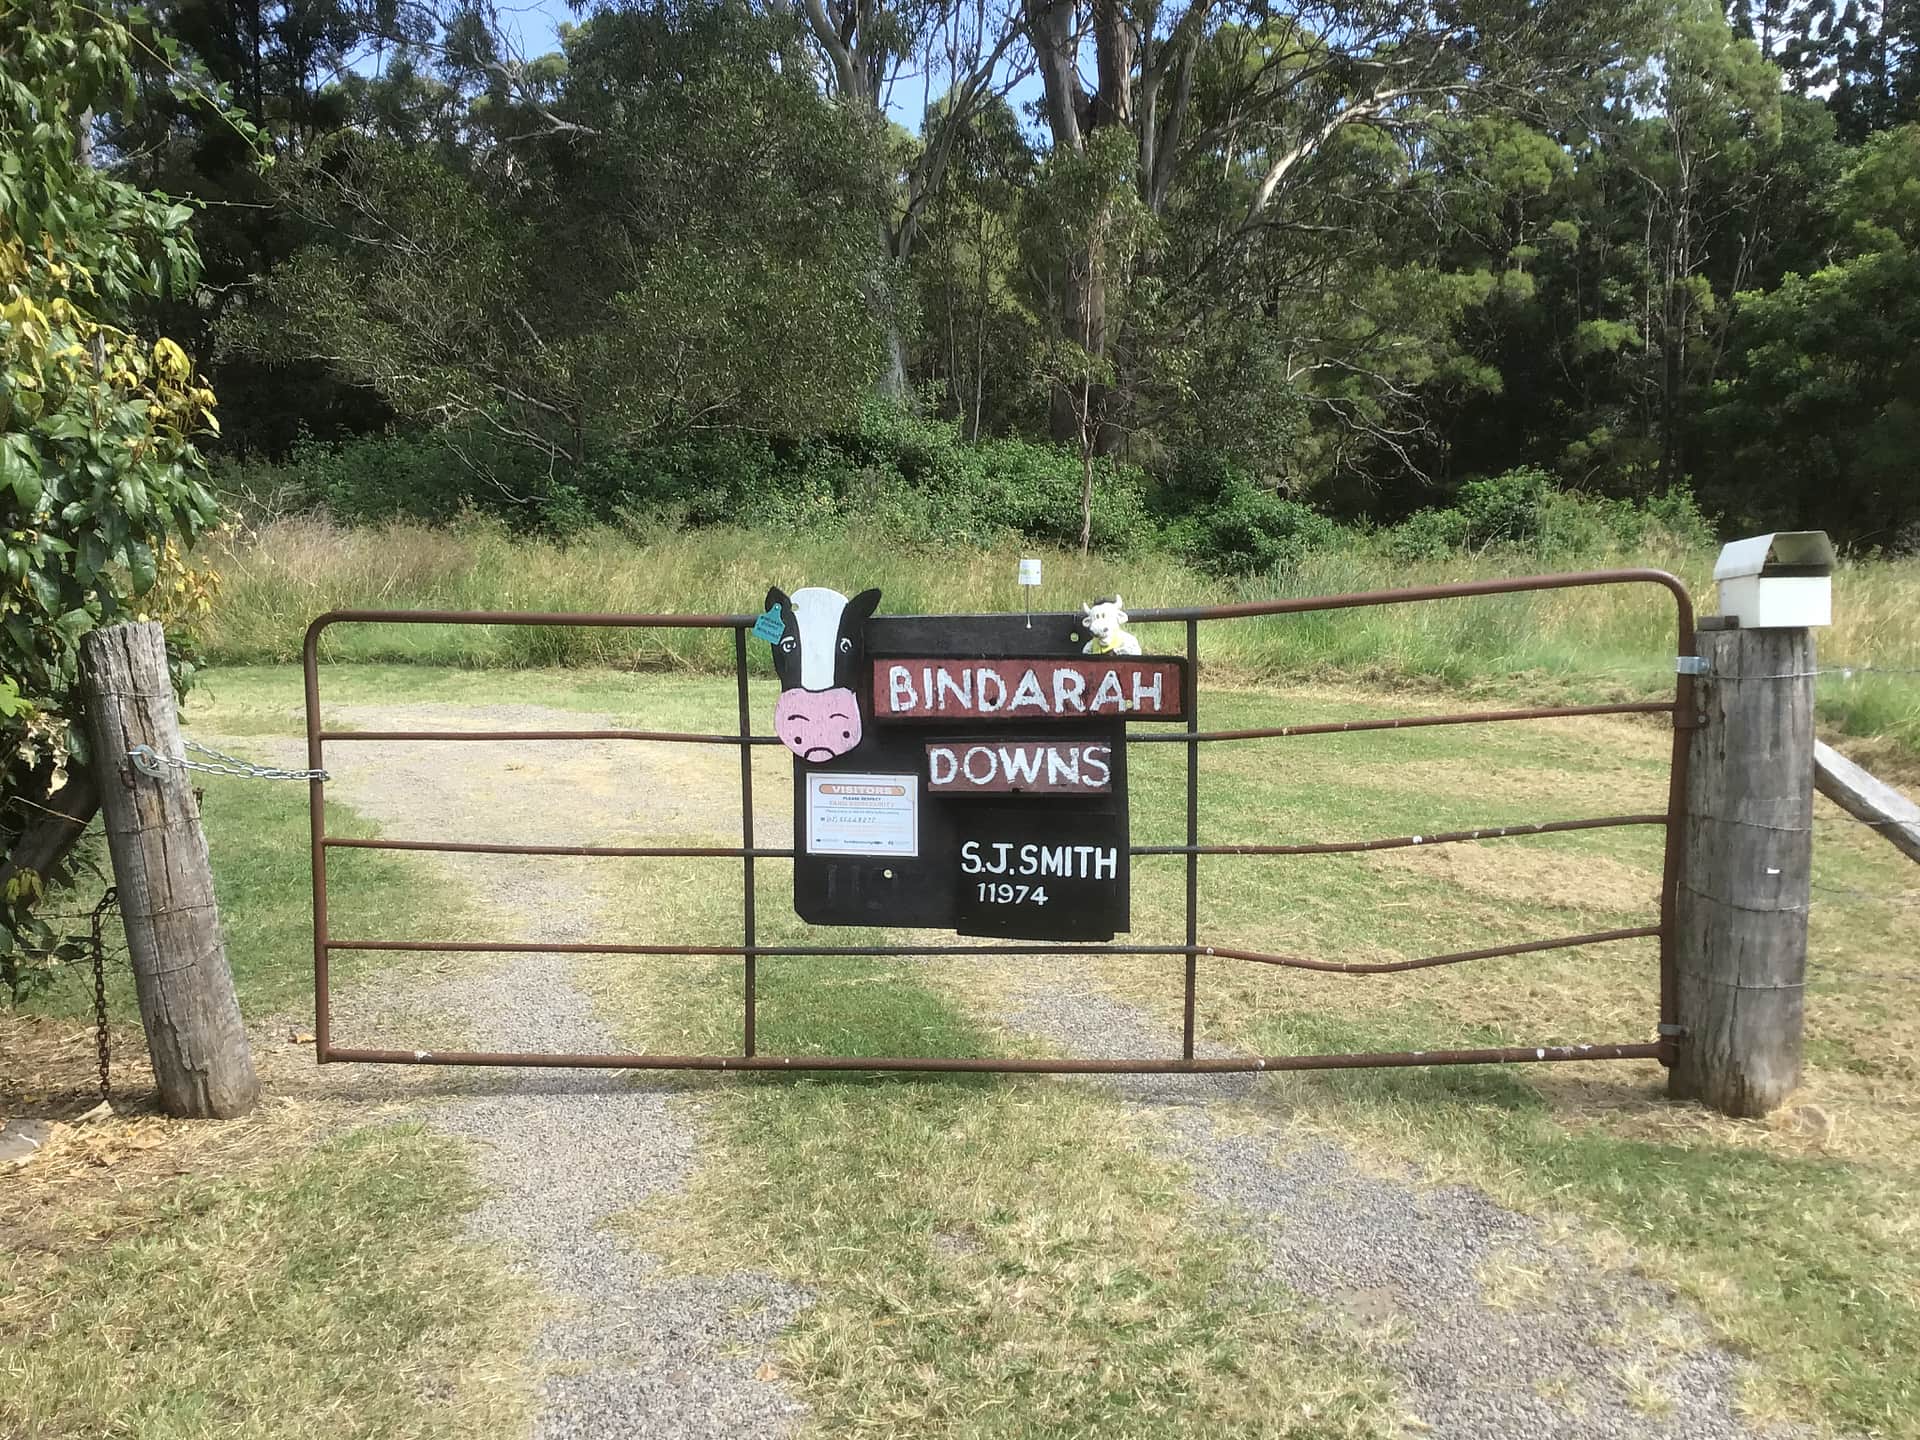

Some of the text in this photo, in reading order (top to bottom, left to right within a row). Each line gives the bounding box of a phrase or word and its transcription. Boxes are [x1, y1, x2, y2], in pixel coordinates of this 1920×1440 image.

[889, 665, 1162, 713] BINDARAH
[929, 746, 1111, 787] DOWNS
[832, 785, 893, 795] VISITORS
[976, 883, 1048, 906] 11974
